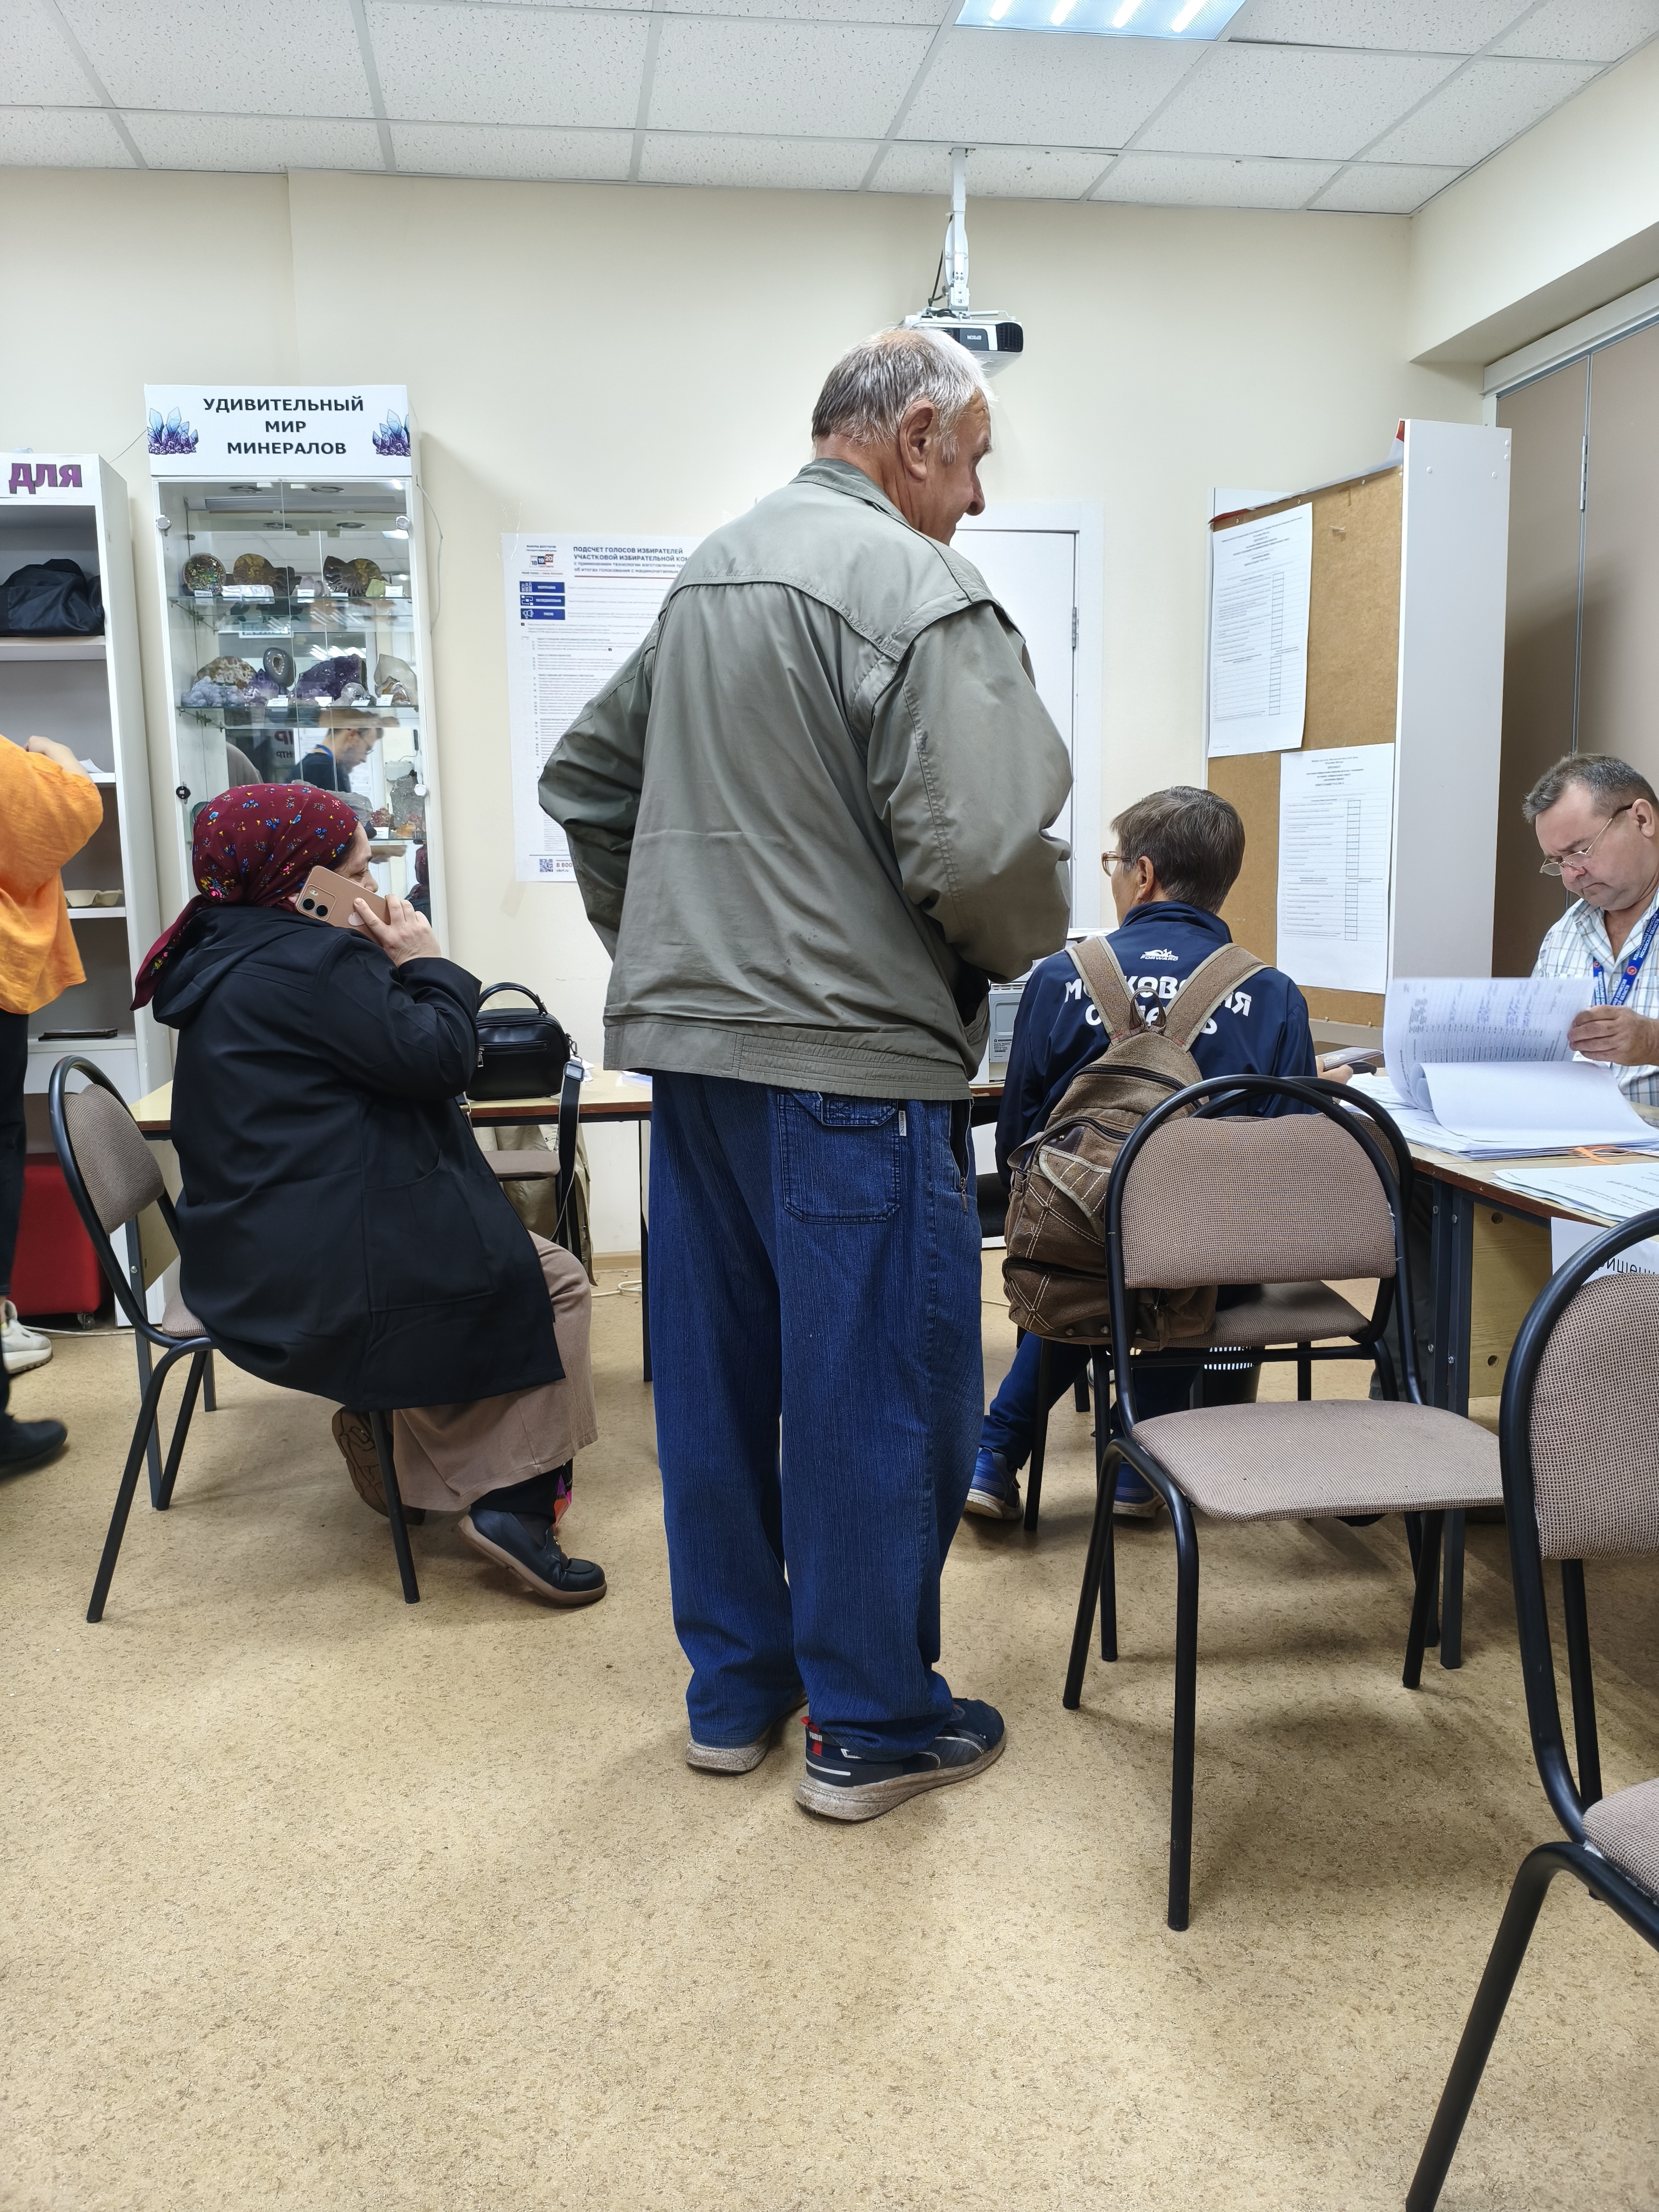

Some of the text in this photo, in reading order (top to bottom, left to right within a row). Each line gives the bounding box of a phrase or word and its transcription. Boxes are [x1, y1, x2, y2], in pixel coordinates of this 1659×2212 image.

[203, 397, 364, 413] УДИВИТЕЛЬНЫЙ
[265, 420, 307, 433] МИР
[227, 442, 347, 455] МИНЕРАЛОВ
[9, 463, 83, 494] ДЛЯ
